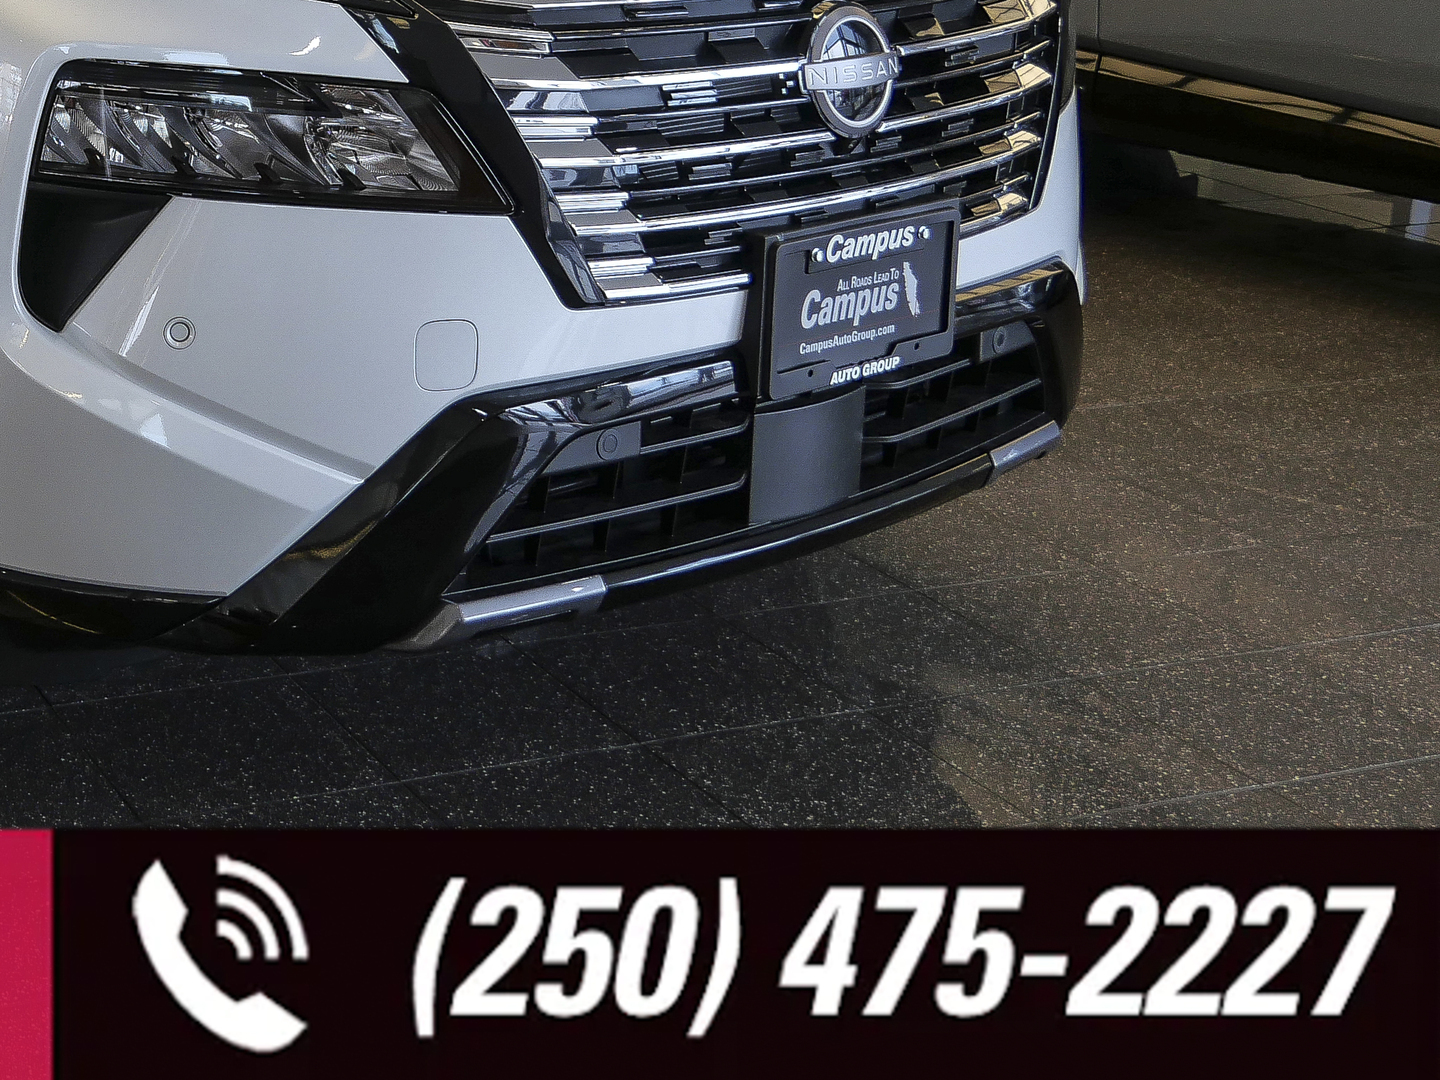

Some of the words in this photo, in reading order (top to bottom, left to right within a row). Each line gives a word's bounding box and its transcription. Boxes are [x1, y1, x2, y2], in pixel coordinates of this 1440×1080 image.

[809, 57, 898, 85] NISSAN
[826, 226, 916, 263] Campus
[837, 279, 850, 292] ALL
[801, 283, 899, 329] Campus
[800, 325, 895, 354] CampusAutoGroup.com
[830, 367, 860, 385] AUTO
[862, 356, 900, 377] GROUP
